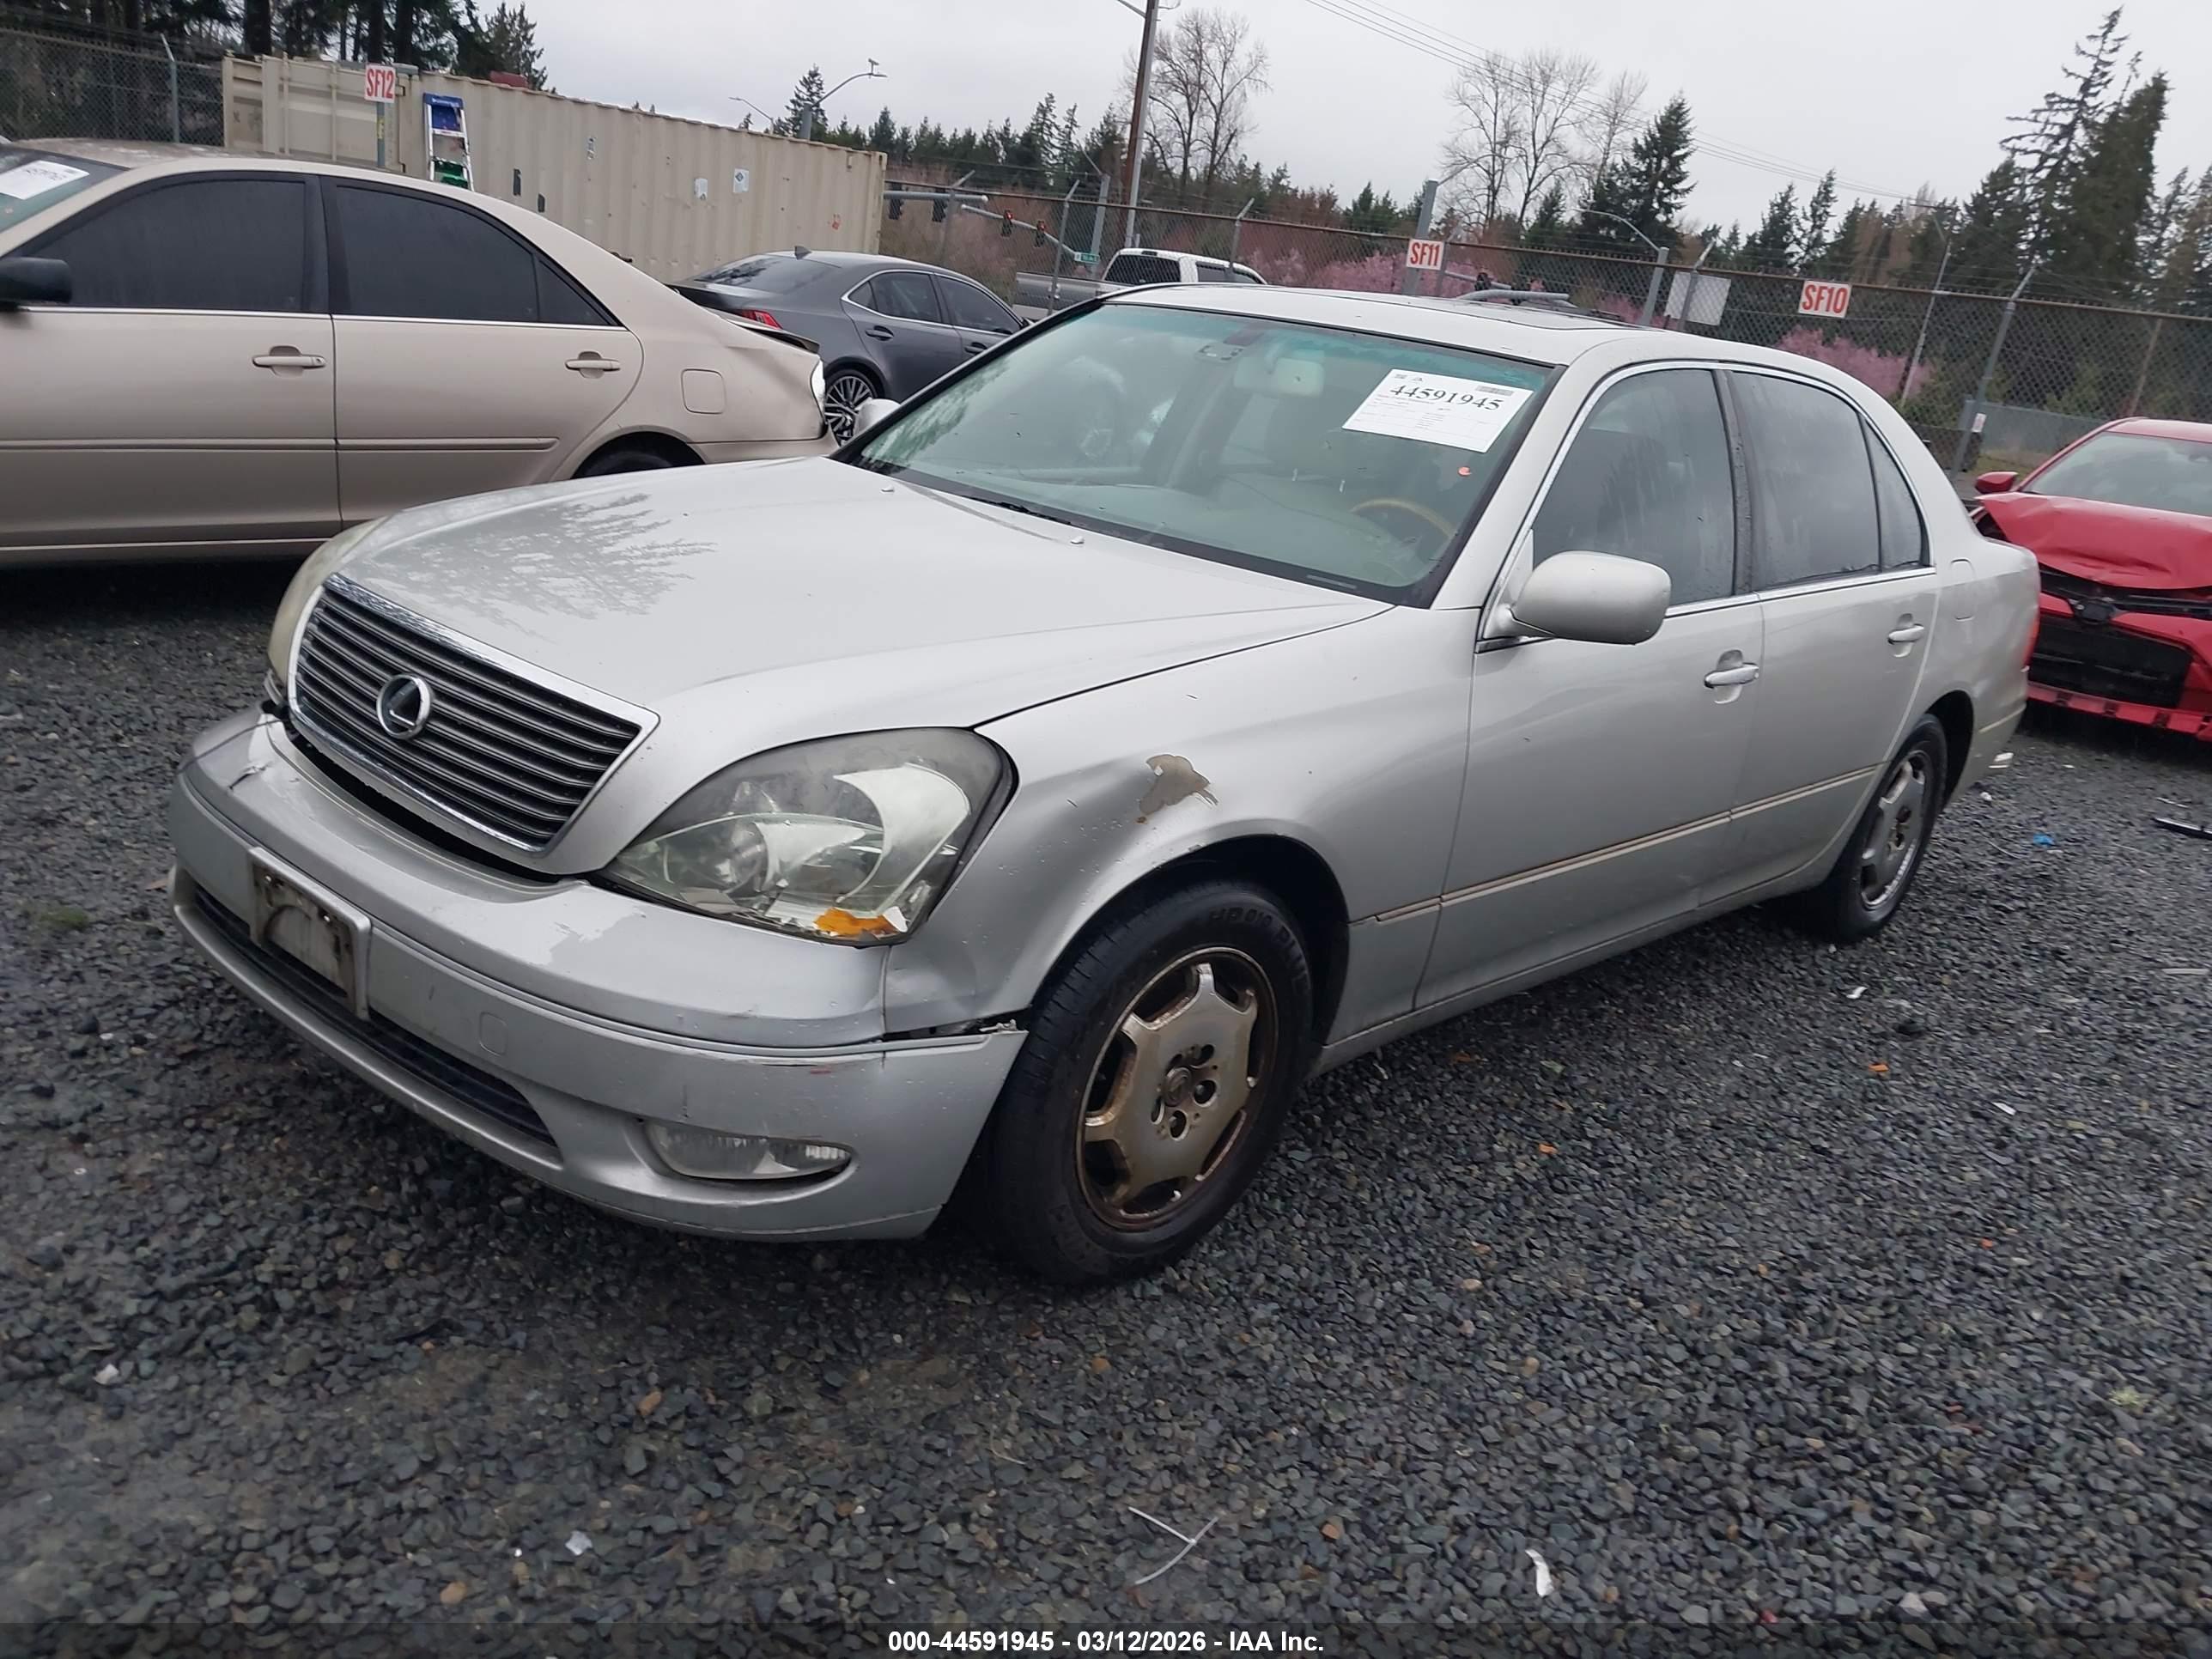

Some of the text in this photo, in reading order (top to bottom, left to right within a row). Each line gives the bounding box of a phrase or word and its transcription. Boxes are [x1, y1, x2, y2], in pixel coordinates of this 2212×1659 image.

[367, 69, 394, 99] SF12
[1410, 242, 1440, 266] SF11
[1802, 284, 1848, 313] SF10
[1390, 385, 1504, 410] 44591945
